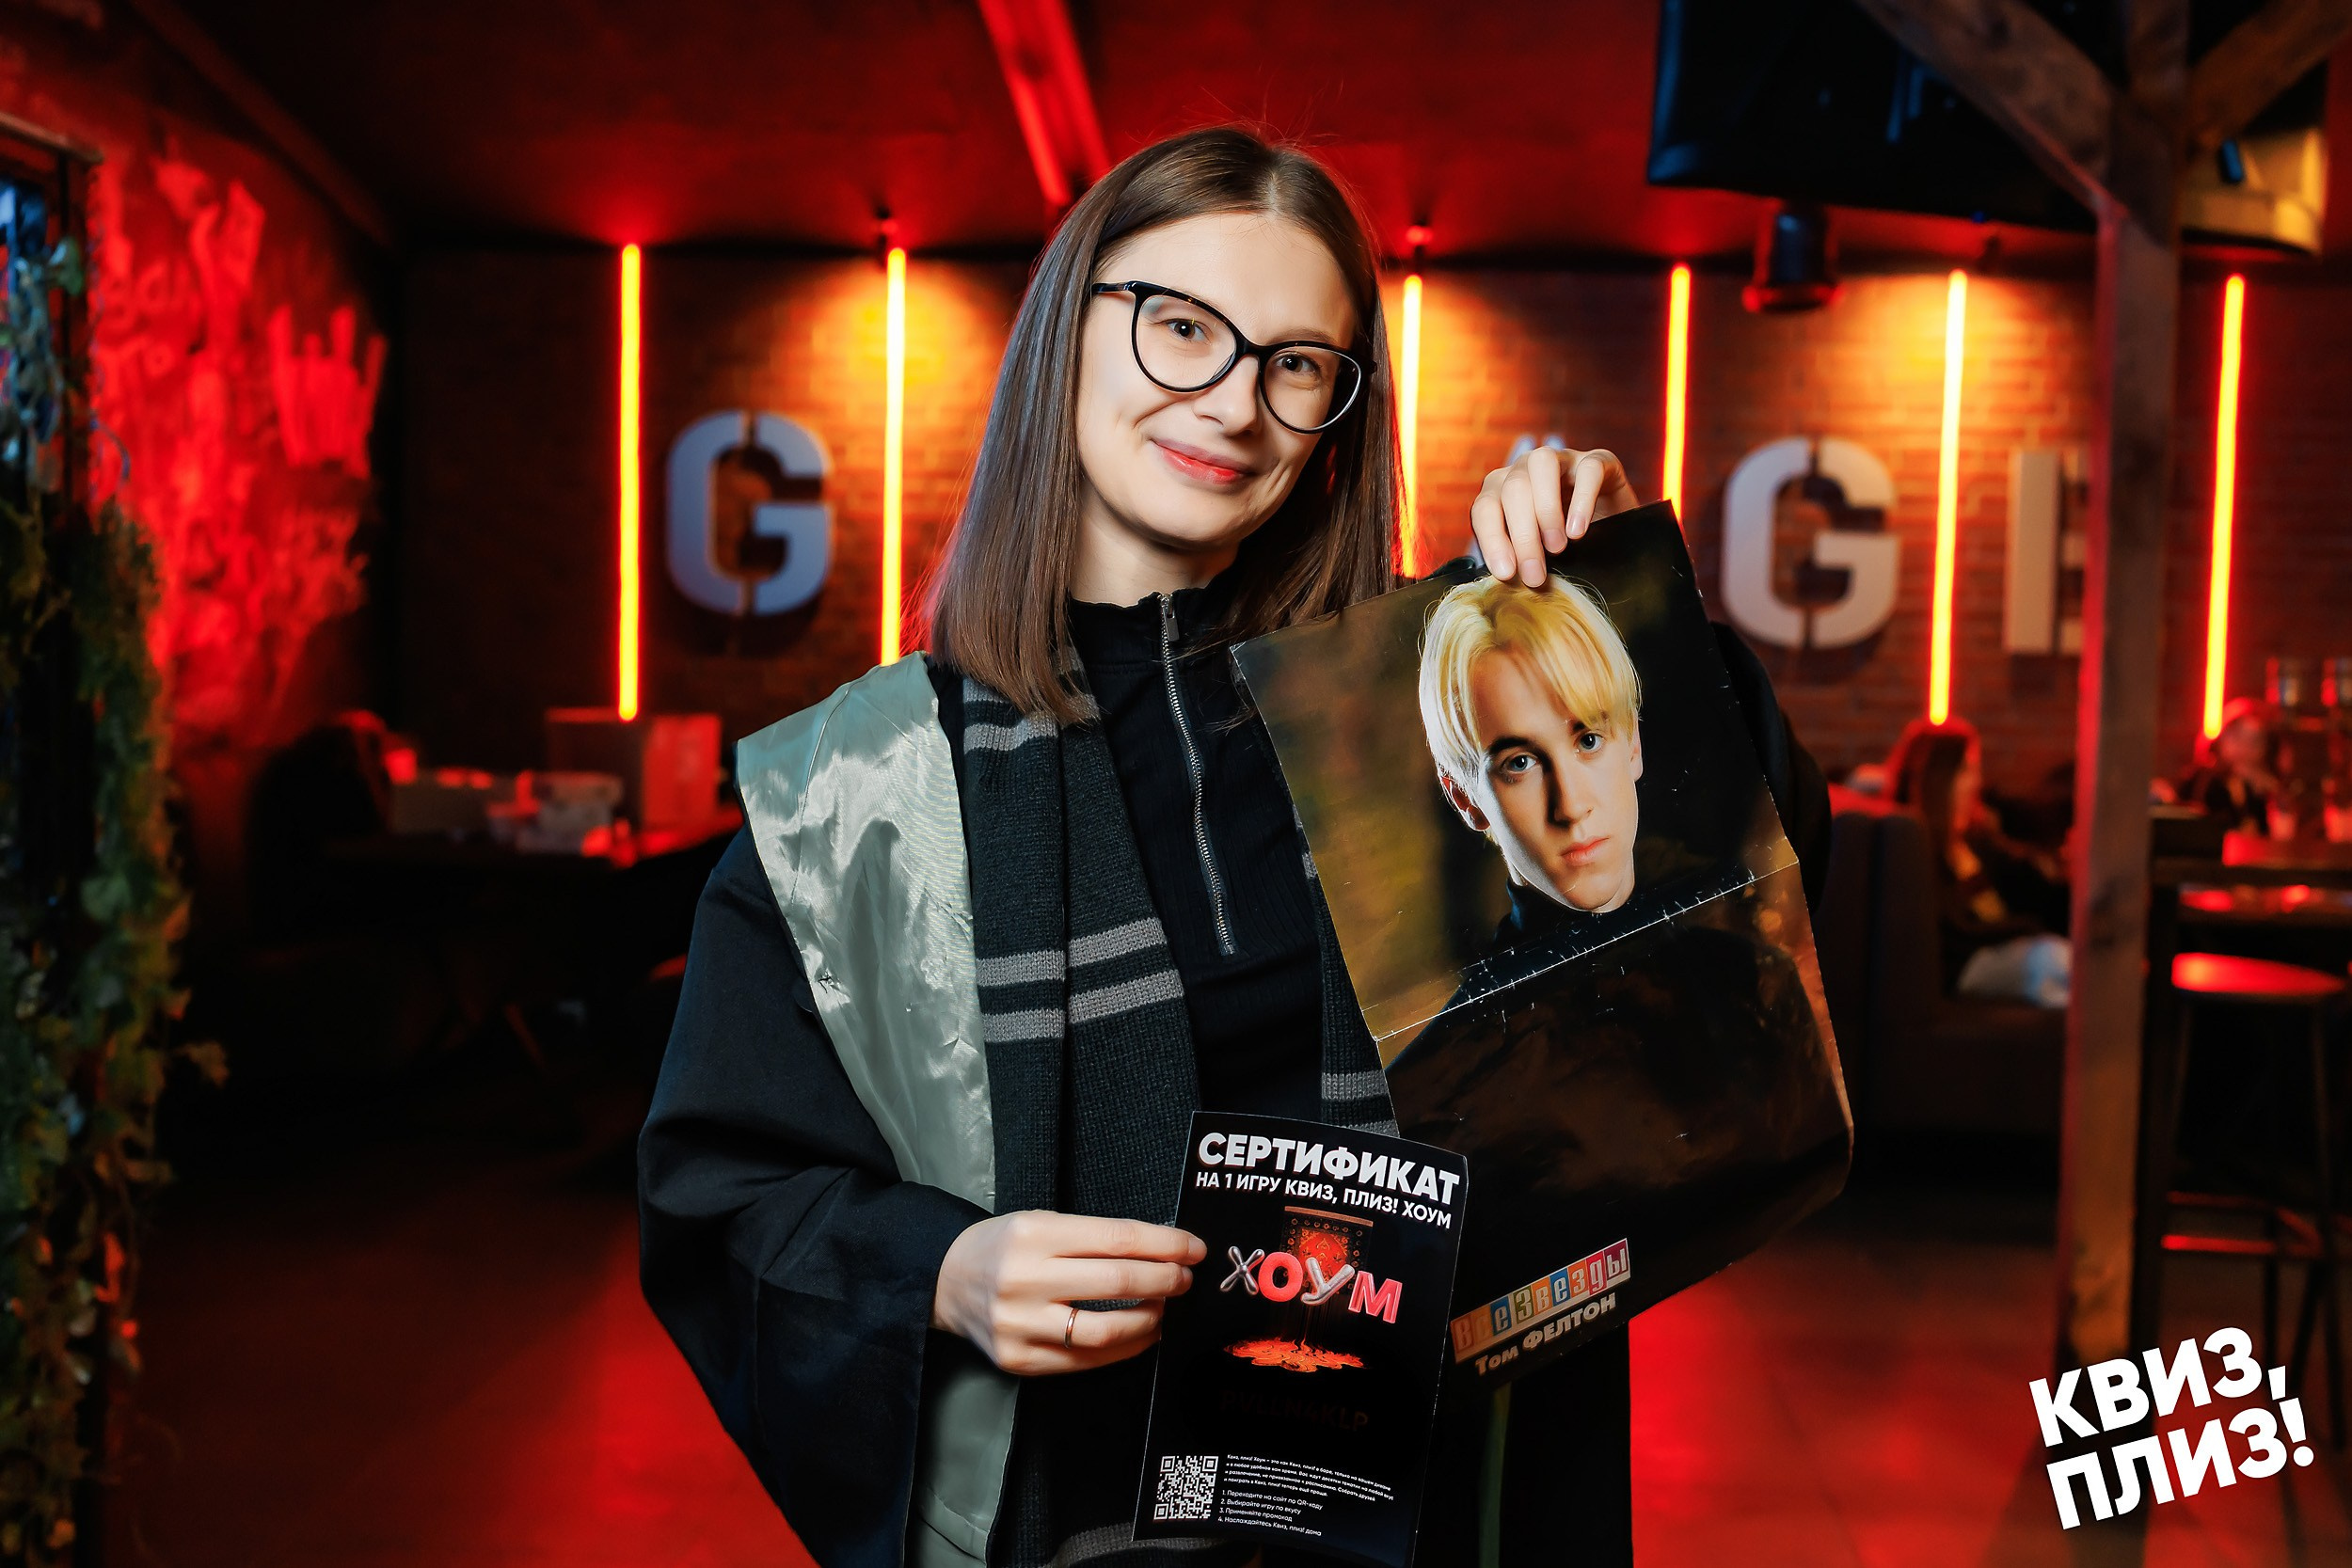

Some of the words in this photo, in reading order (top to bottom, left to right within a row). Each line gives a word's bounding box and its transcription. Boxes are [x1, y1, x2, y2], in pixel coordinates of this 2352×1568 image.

[1199, 1132, 1460, 1206] СЕРТИФИКАТ
[1196, 1171, 1220, 1188] НА
[1225, 1173, 1232, 1189] 1
[1236, 1175, 1281, 1193] ИГРУ
[1285, 1180, 1338, 1204] КВИЗ,
[1343, 1188, 1398, 1214] ПЛИЗ!
[1402, 1202, 1452, 1229] ХОУМ
[1219, 1245, 1403, 1324] ХОУМ
[1522, 1292, 1616, 1349] ФЕЛТОН
[1225, 1508, 1262, 1516] Применяйте
[1262, 1513, 1293, 1522] промокод
[1227, 1490, 1263, 1499] Переходите
[1296, 1498, 1323, 1511] QR-коду
[1227, 1498, 1260, 1508] Выбирайте
[1284, 1507, 1301, 1515] вкусу
[1225, 1517, 1272, 1527] Наслаждайтесь
